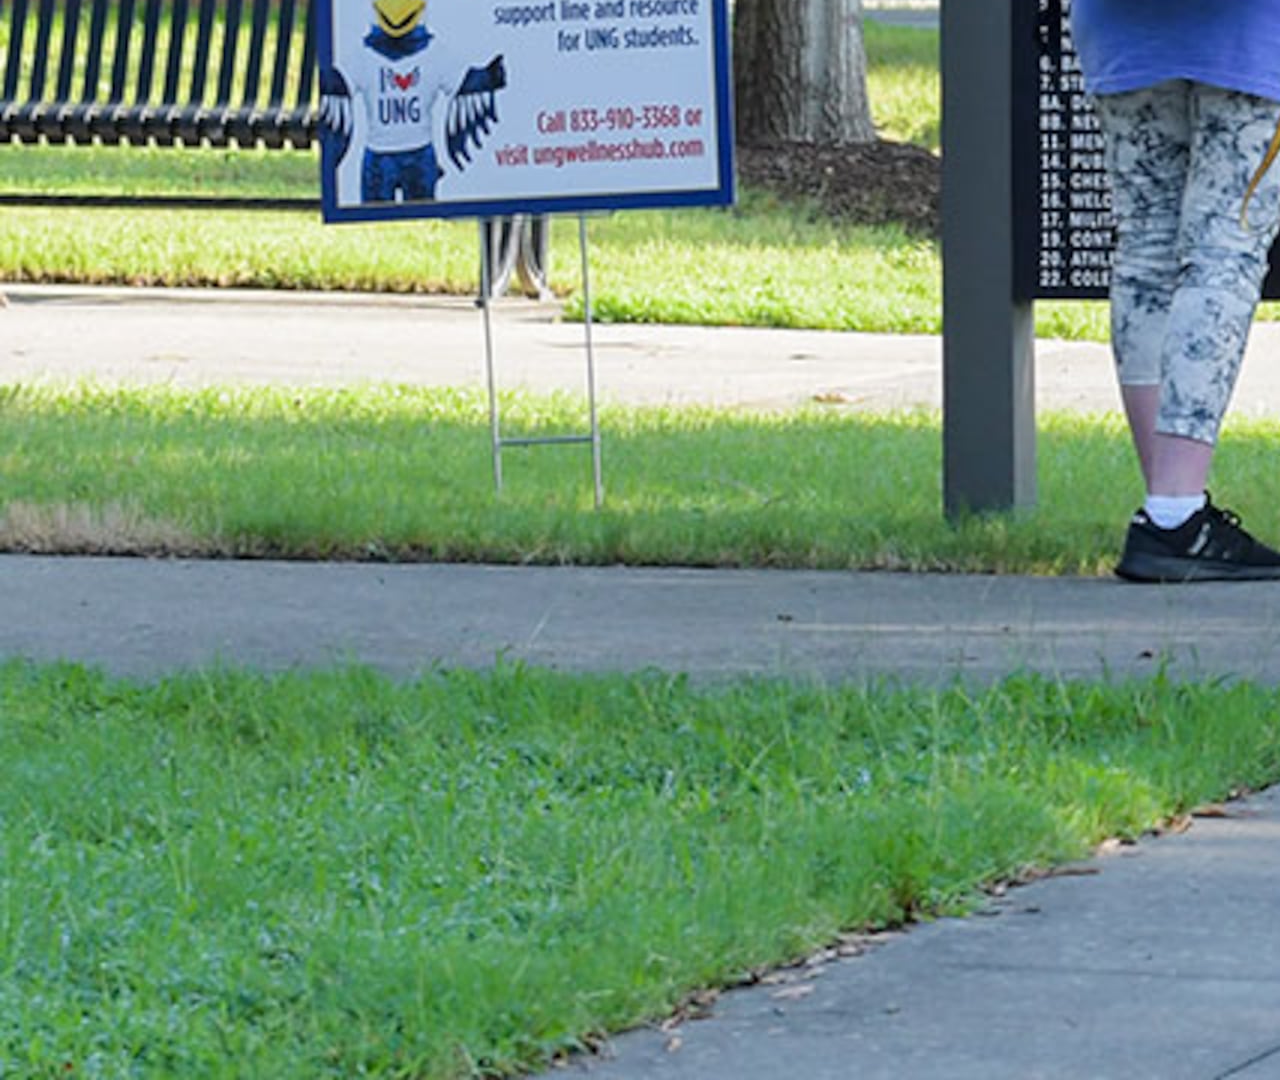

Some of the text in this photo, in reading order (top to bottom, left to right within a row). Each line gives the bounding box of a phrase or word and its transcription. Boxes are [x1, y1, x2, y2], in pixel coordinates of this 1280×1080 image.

[494, 2, 556, 26] support
[560, 0, 590, 20] line
[558, 25, 699, 51] for UNG students.
[379, 96, 420, 126] UNG
[537, 105, 702, 133] Call 833-910-3368 or
[495, 138, 704, 168] visit ungwellnesshub.com
